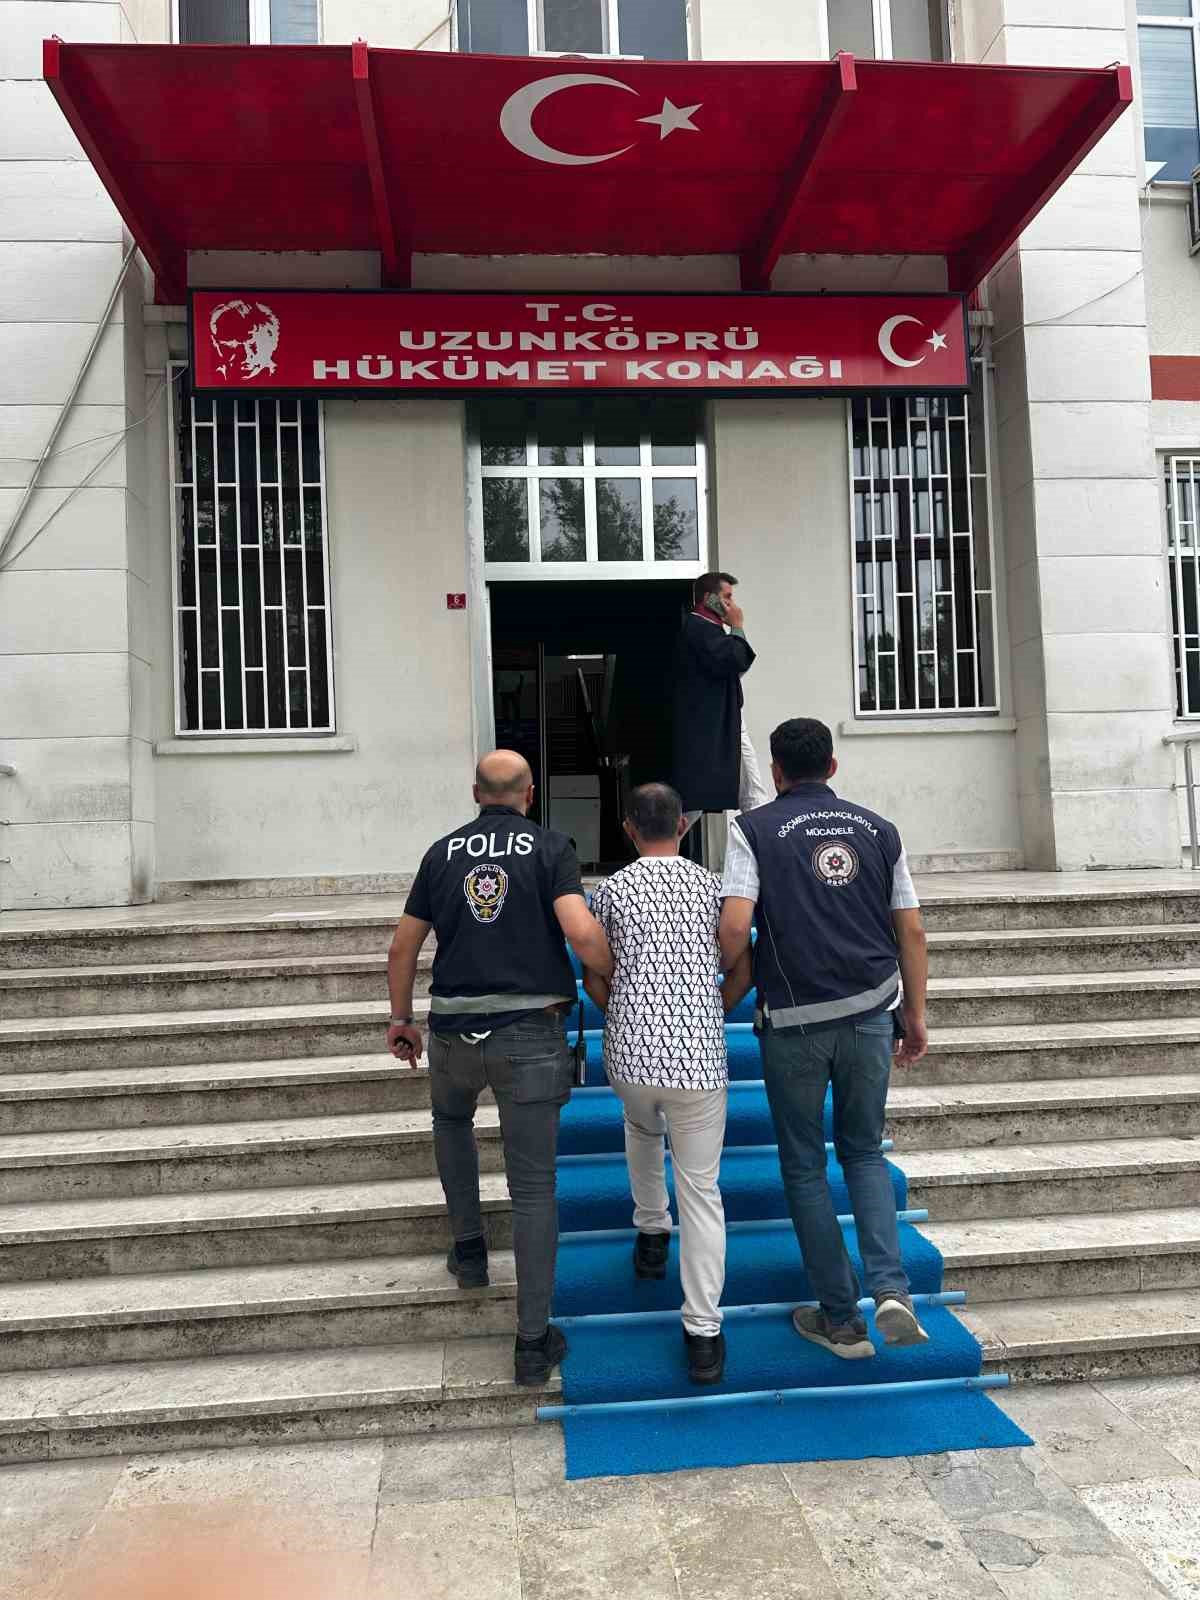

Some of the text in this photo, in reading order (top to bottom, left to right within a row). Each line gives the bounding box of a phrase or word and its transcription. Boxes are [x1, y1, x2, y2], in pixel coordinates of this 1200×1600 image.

[526, 303, 633, 322] T.C.
[399, 326, 760, 351] UZUNKÖPRÜ
[312, 354, 843, 381] HÜKÜMET KONAĞI
[778, 813, 811, 838] GÖÇMEN
[806, 826, 855, 836] MÜCADELE
